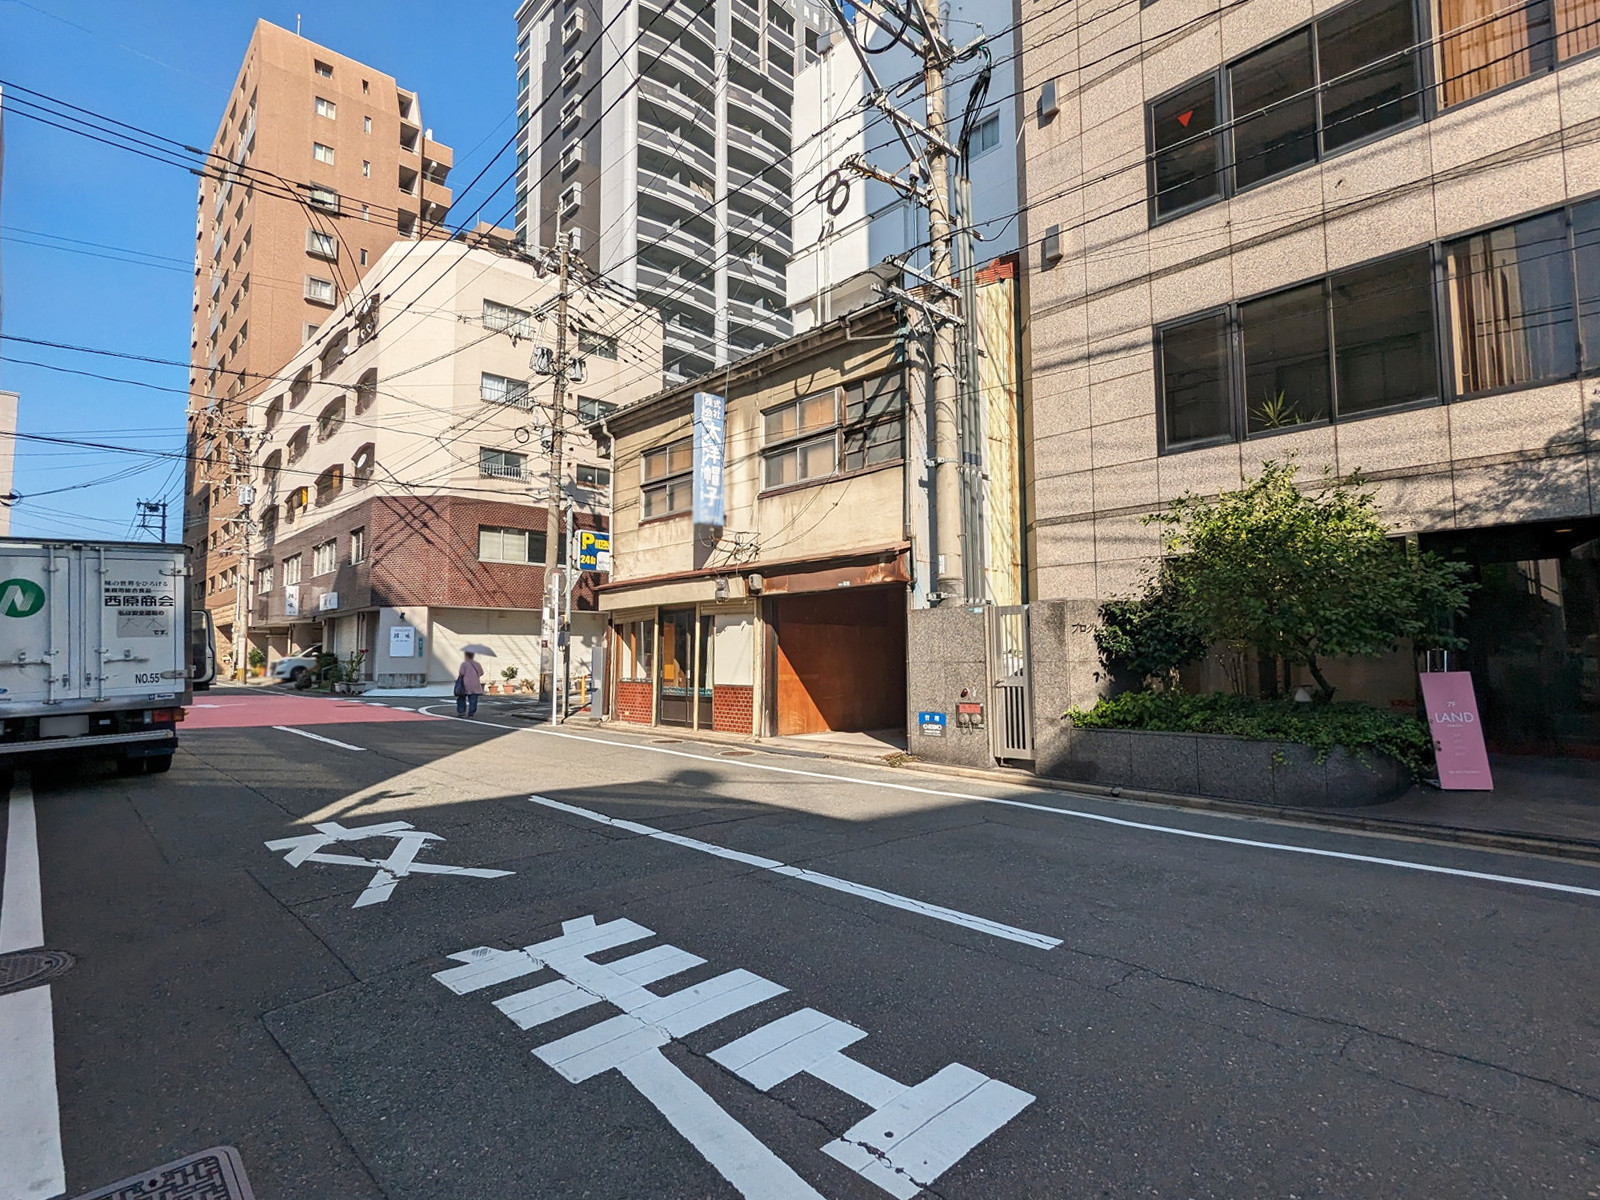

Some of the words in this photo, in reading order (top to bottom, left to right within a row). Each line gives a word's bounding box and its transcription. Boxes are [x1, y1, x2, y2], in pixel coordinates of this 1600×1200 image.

[704, 395, 721, 410] 株式
[704, 408, 721, 420] 会社
[581, 532, 595, 550] P
[104, 595, 174, 607] 西原商会
[135, 673, 160, 684] NO.55
[1434, 712, 1474, 723] LAND
